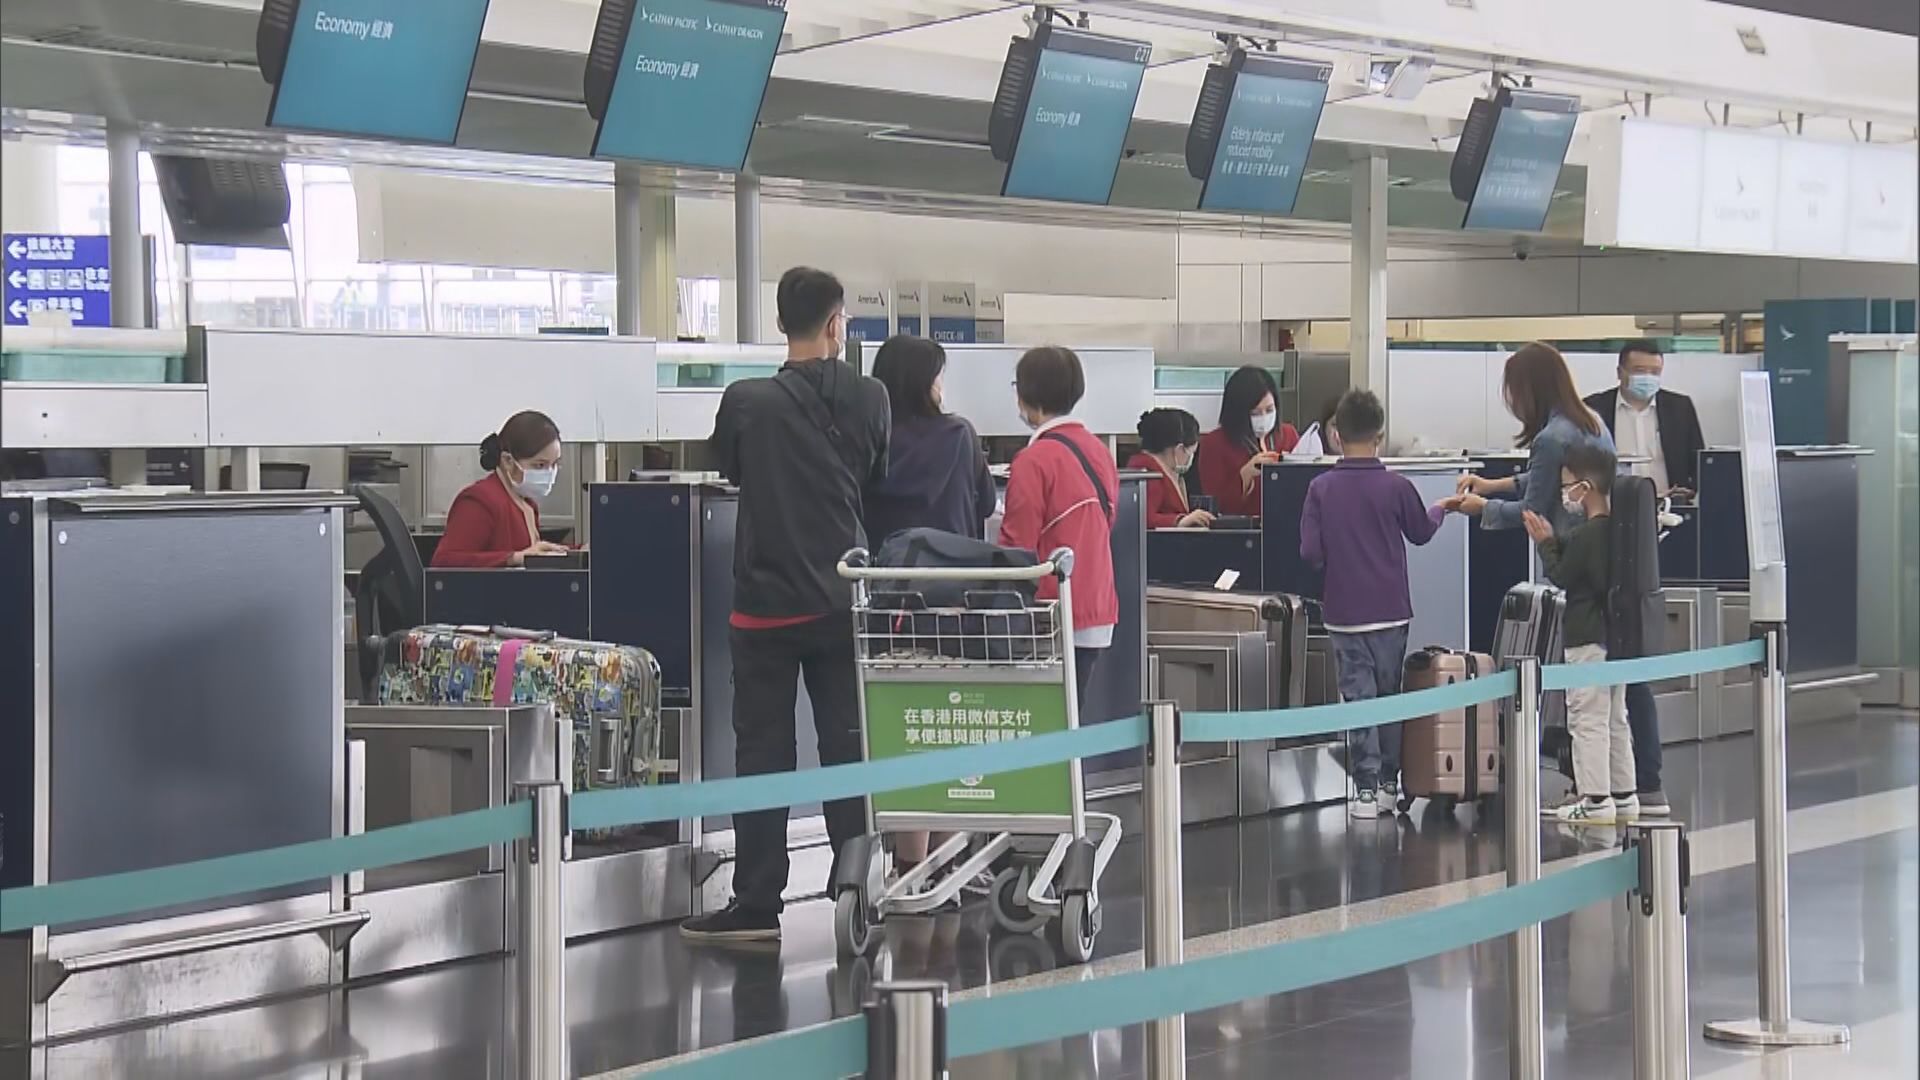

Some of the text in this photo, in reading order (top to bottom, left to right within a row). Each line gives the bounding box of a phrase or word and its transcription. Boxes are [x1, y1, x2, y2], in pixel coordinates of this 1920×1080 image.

[315, 11, 370, 40] Economy
[649, 13, 698, 30] CATHAY PACIFIC
[713, 23, 763, 39] CATHAY DRAGON
[635, 55, 681, 80] Economy
[1036, 107, 1067, 128] Economy
[858, 295, 879, 305] American
[943, 295, 965, 304] American
[934, 331, 964, 341] CHECK-IN
[904, 708, 1031, 726] 在香港用微信支付
